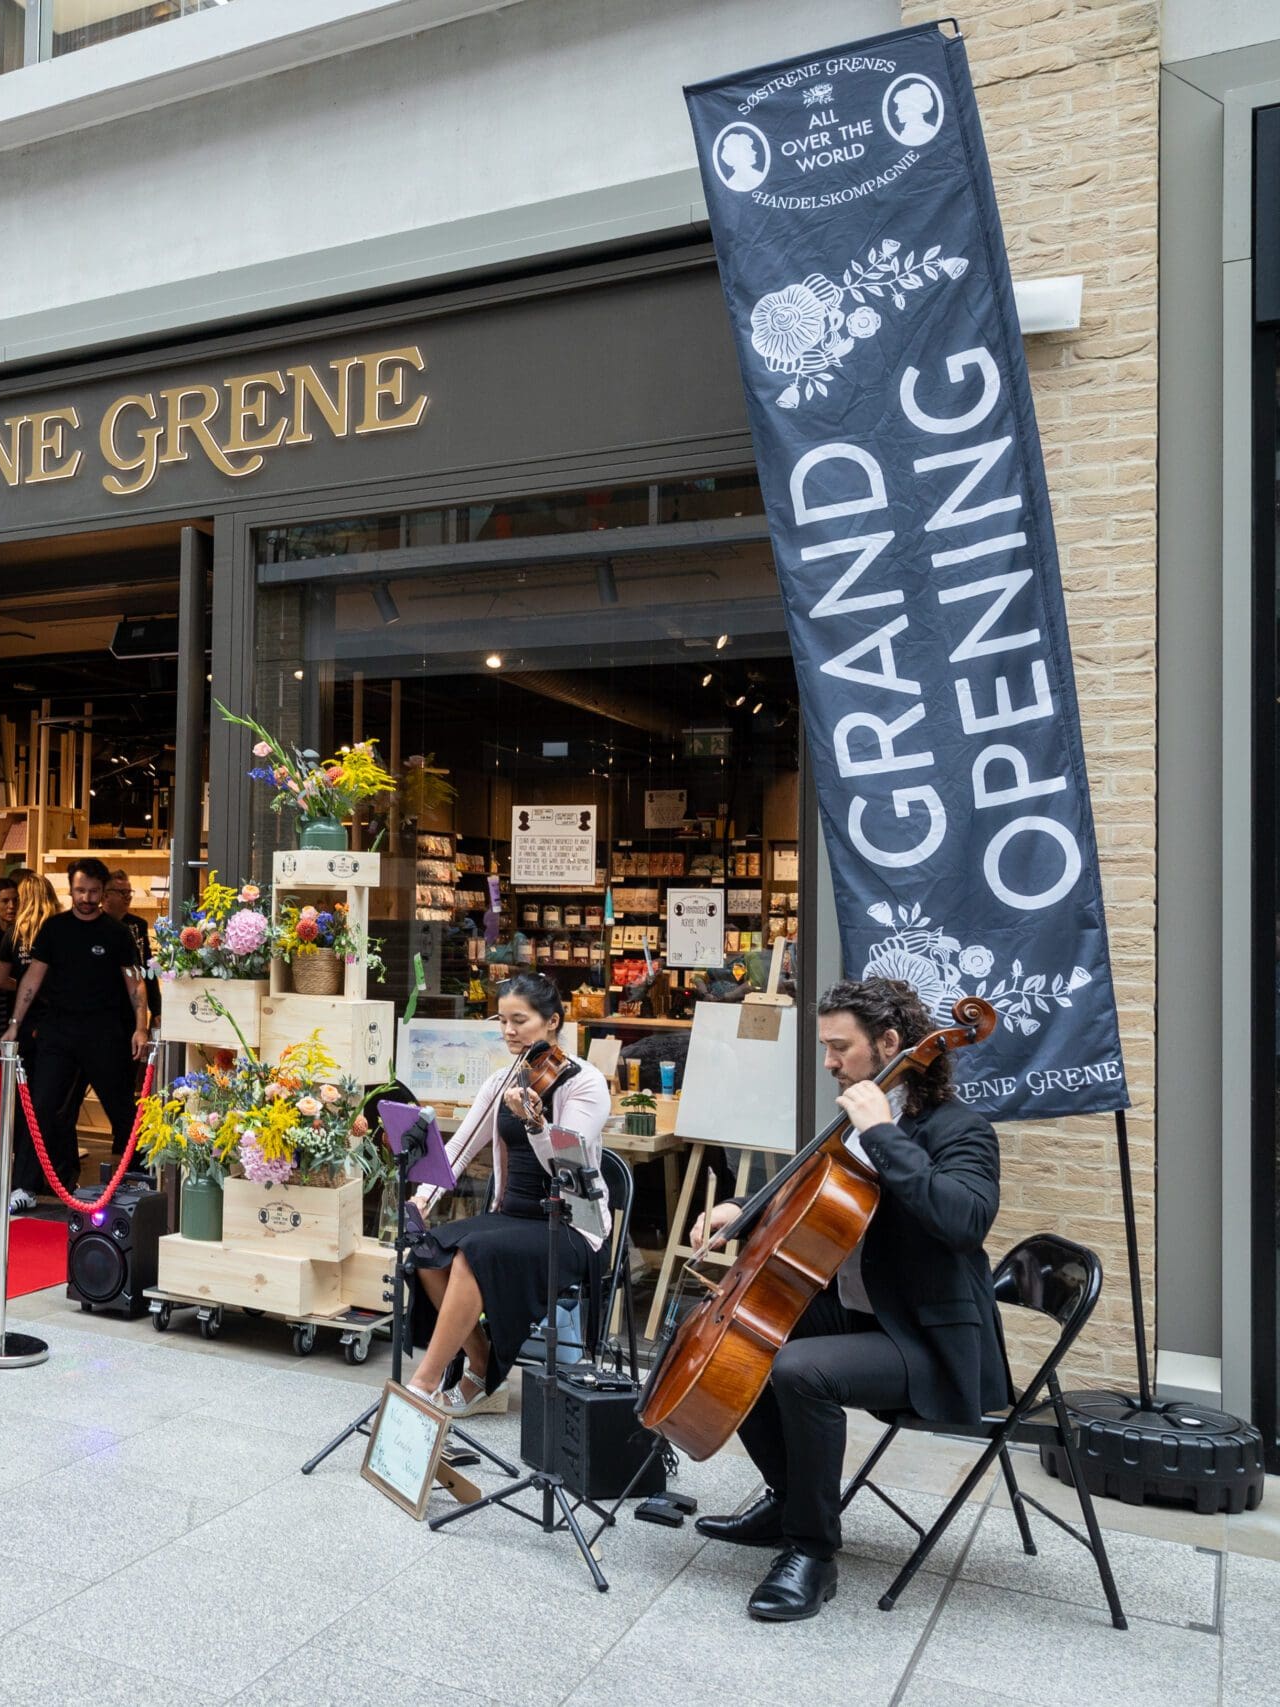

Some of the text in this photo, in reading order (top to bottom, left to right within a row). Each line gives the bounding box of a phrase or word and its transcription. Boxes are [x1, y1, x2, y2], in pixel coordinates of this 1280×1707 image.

[737, 56, 897, 116] SØSTRENE GRENES
[781, 119, 874, 157] OVER THE
[808, 109, 840, 130] ALL
[751, 149, 920, 210] HANDELSKOMPAGNIE
[795, 143, 865, 173] WORLD
[99, 345, 427, 496] GRENE
[789, 442, 948, 869] GRAND
[898, 346, 1083, 911] OPENING
[947, 1060, 1122, 1105] RENE GRENE
